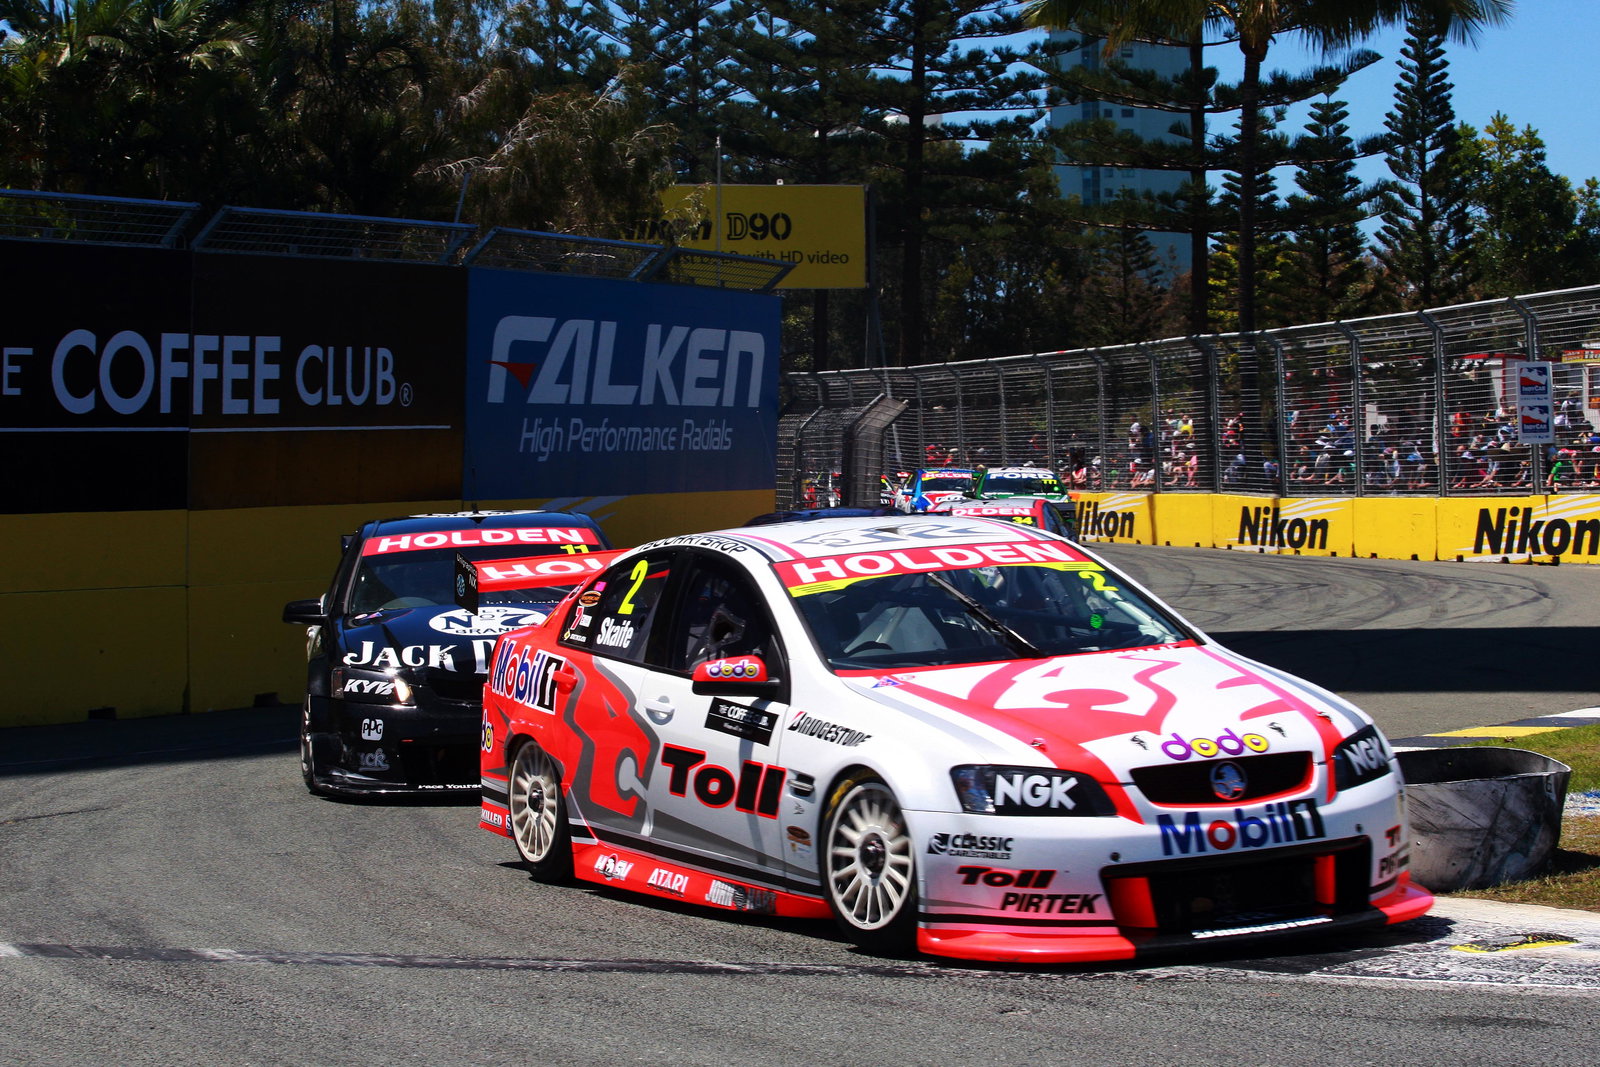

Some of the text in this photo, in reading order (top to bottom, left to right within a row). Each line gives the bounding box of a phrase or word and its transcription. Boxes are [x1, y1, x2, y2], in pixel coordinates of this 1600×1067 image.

[727, 212, 792, 241] D90
[781, 250, 804, 265] HD
[806, 250, 849, 264] video
[51, 329, 281, 415] COFFEE
[295, 344, 396, 406] CLUB
[487, 315, 765, 408] FALKEN
[519, 418, 733, 462] High Performance Radials
[989, 472, 1054, 480] FORD
[1012, 516, 1033, 525] 34
[1238, 506, 1328, 549] Nikon
[1473, 506, 1600, 555] Nikon
[377, 528, 584, 552] HOLDEN
[560, 544, 589, 556] 11
[792, 543, 1075, 583] HOLDEN
[617, 560, 649, 615] 2
[1078, 570, 1119, 592] 2
[597, 616, 634, 648] Skaife
[343, 640, 458, 673] JACK
[707, 659, 760, 679] dodo
[343, 678, 395, 696] KYB
[788, 711, 873, 747] BRIDGESTONE
[1161, 727, 1270, 761] dodo
[1343, 735, 1389, 776] NGK
[661, 742, 788, 821] Toll
[994, 774, 1079, 811] NGK
[952, 834, 1014, 852] CLASSIC
[1156, 800, 1293, 856] Mobil
[647, 867, 690, 893] ATARI
[956, 865, 1057, 889] Toll
[1000, 892, 1103, 914] PIRTEK
